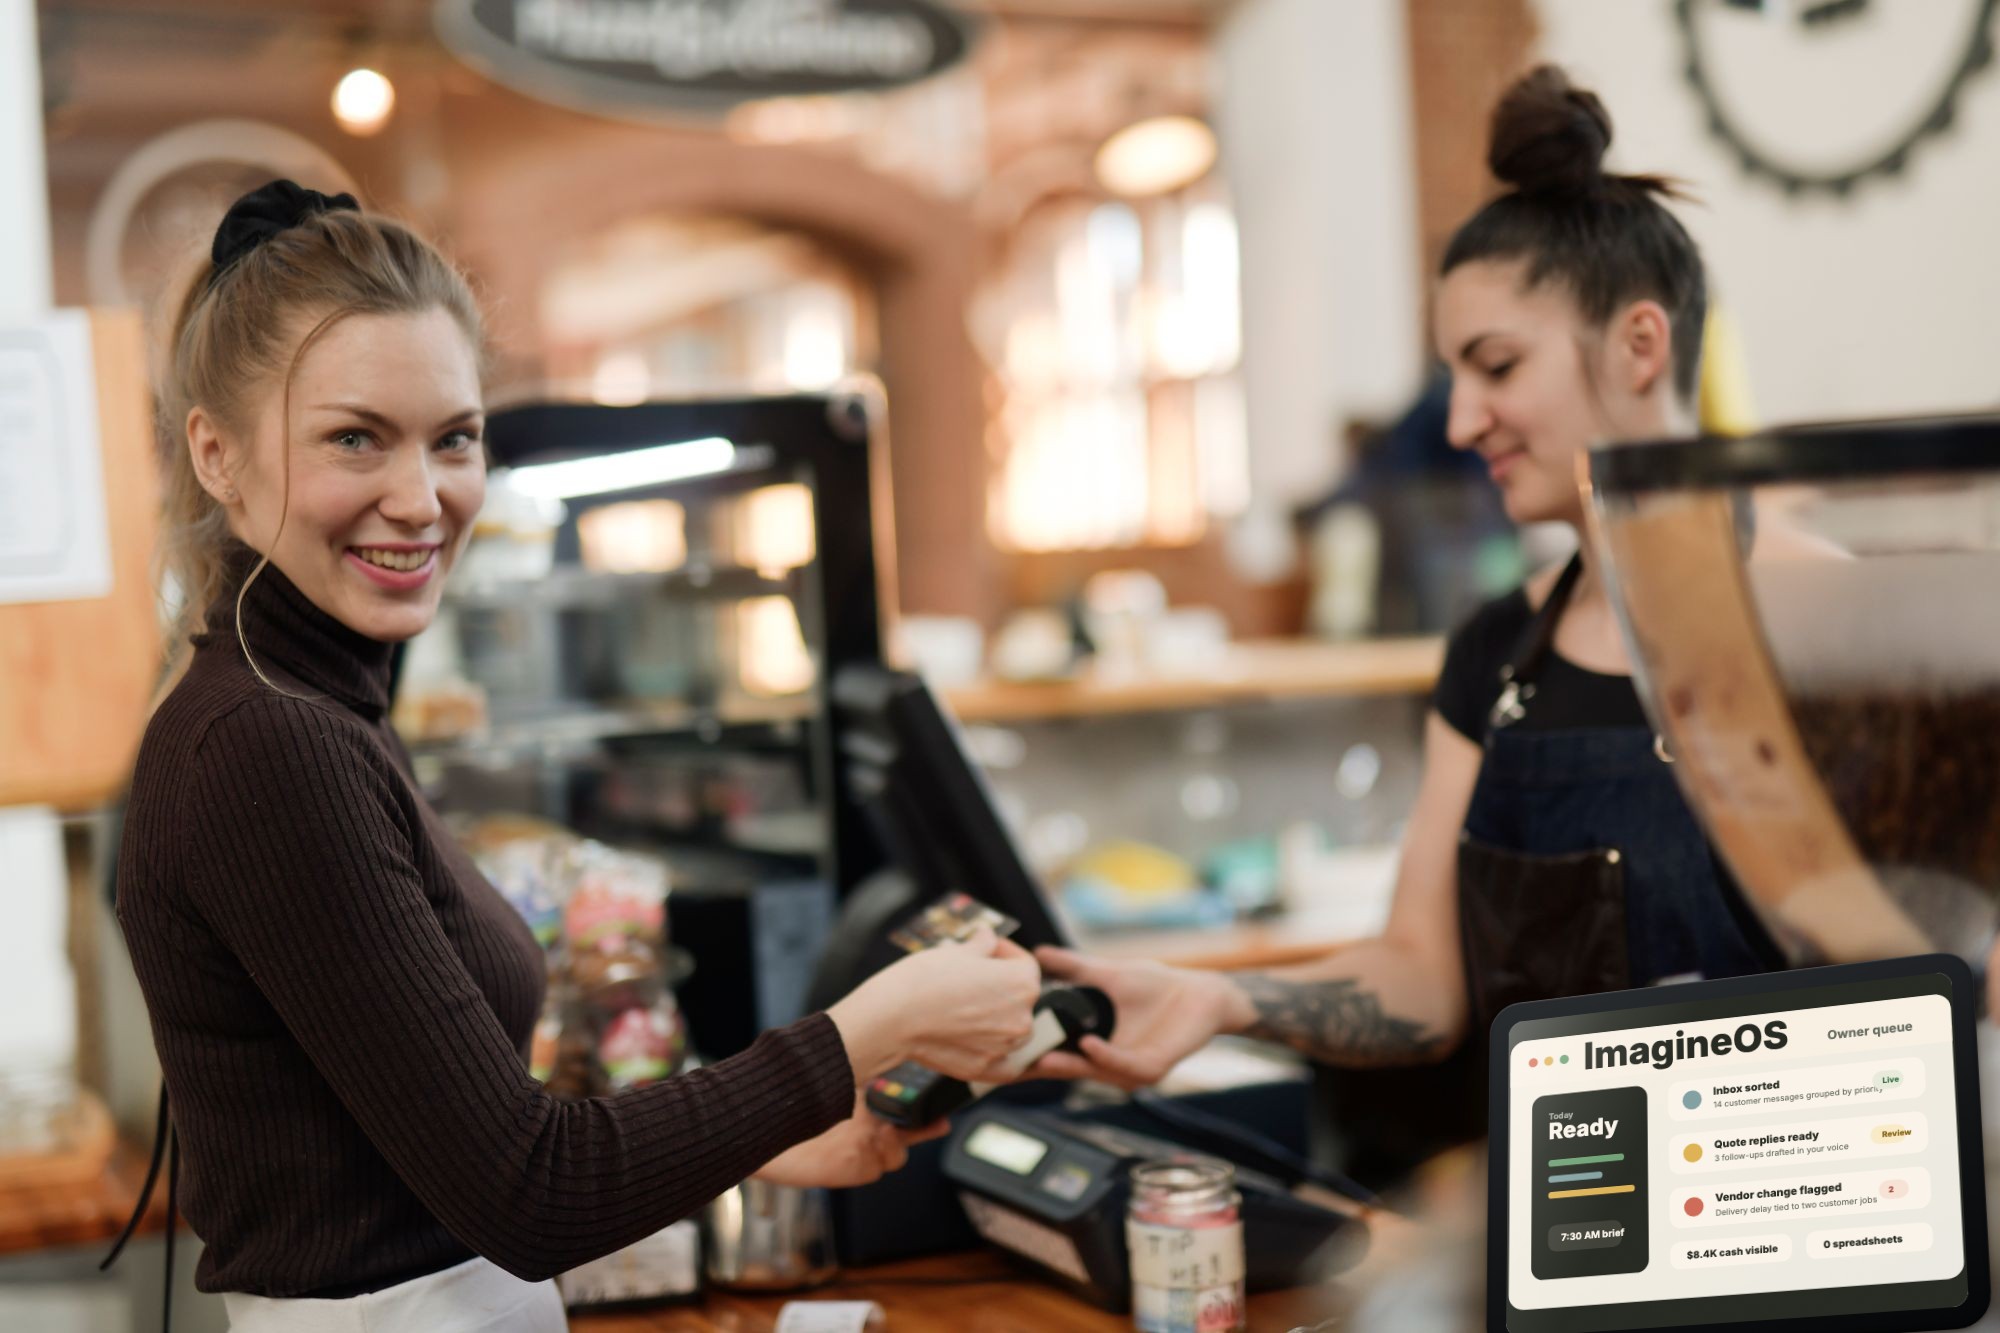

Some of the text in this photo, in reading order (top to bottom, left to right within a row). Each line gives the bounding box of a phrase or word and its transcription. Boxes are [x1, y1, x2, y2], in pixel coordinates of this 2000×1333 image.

[1827, 1023, 1913, 1040] Owner queue
[1584, 1020, 1788, 1070] ImagineOS
[1713, 1080, 1780, 1096] Inbox sorted
[1882, 1076, 1900, 1084] Live
[1724, 1097, 1761, 1108] customer
[1763, 1092, 1804, 1103] messages
[1806, 1088, 1840, 1100] grouped
[1842, 1088, 1853, 1097] by
[1548, 1112, 1574, 1121] Today
[1549, 1117, 1619, 1140] Ready
[1881, 1129, 1912, 1138] Review
[1714, 1131, 1820, 1149] Quote replies ready
[1714, 1142, 1849, 1162] 3 follow-ups drafted in your voice
[1715, 1182, 1843, 1202] Vendor change flagged
[1715, 1206, 1748, 1217] Delivery
[1750, 1204, 1772, 1214] delay
[1774, 1203, 1790, 1212] tied
[1801, 1201, 1817, 1209] two
[1819, 1198, 1858, 1208] customer
[1859, 1196, 1878, 1206] jobs
[1560, 1228, 1625, 1241] 7:30 AM brief
[1823, 1235, 1903, 1249] 0 spreadsheets
[1687, 1245, 1778, 1260] $8.4K cash visible
